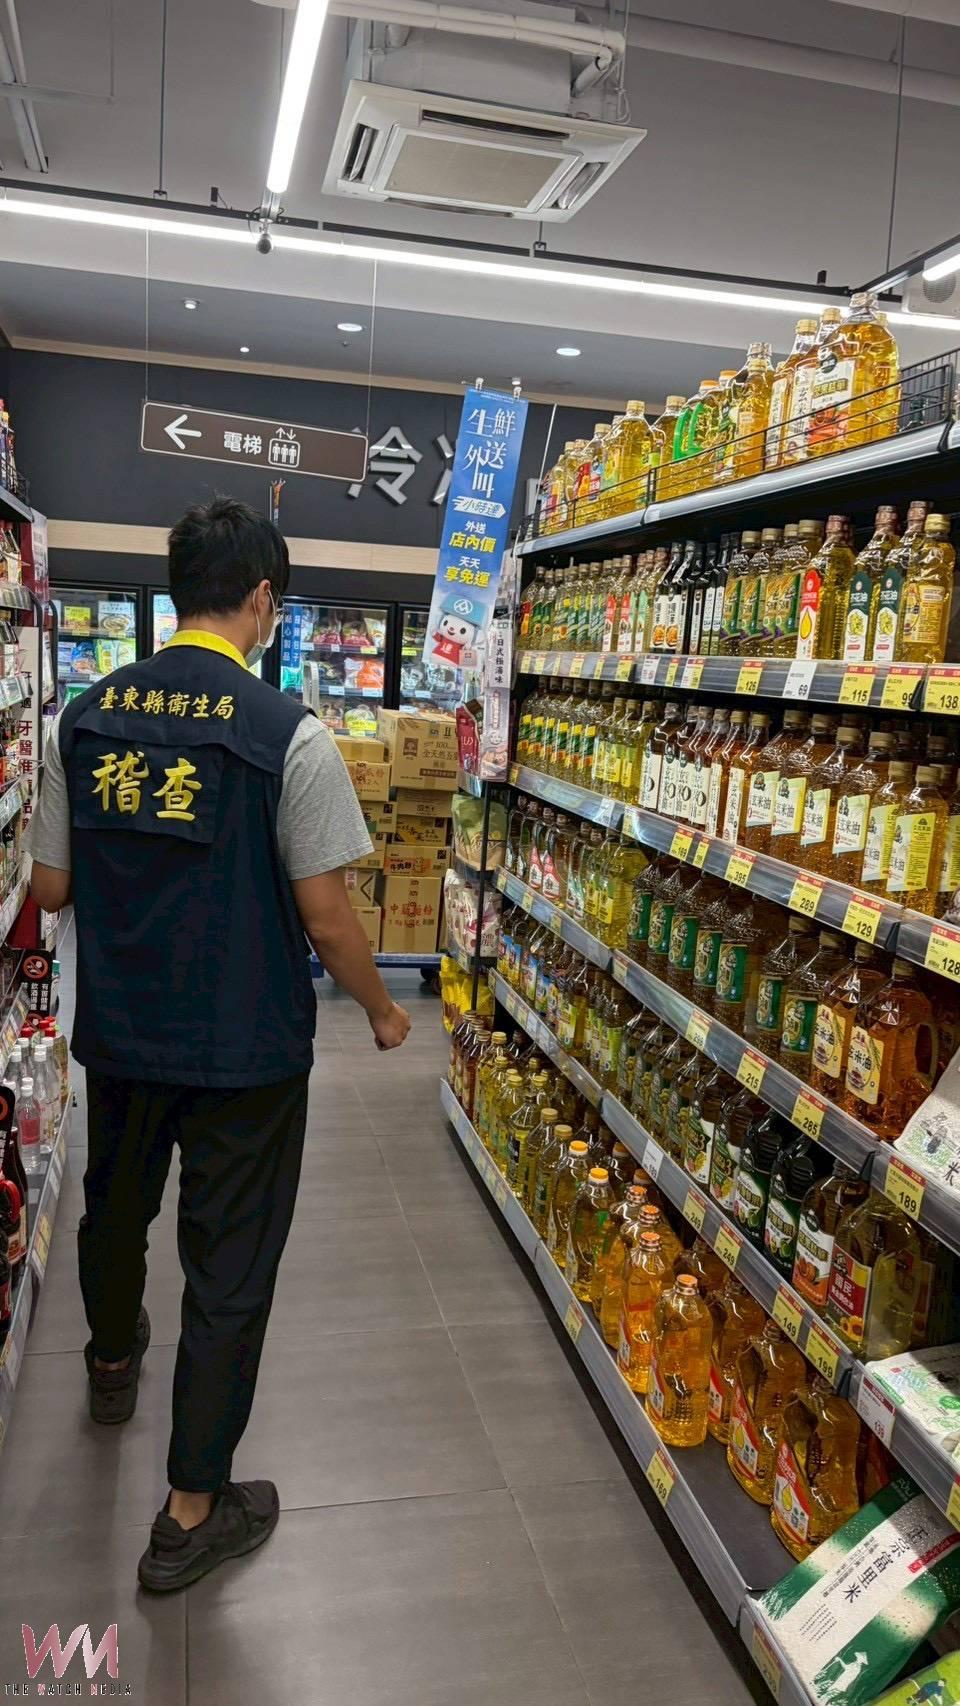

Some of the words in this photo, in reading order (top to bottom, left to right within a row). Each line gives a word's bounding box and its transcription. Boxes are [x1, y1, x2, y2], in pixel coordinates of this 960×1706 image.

[465, 407, 516, 438] 生鮮
[223, 431, 263, 456] 電梯
[465, 520, 486, 535] 外送
[449, 532, 497, 553] 店內價
[459, 556, 480, 569] 天天
[444, 566, 491, 588] 享免運
[99, 685, 235, 720] 臺東縣衛生局
[851, 689, 868, 702] 115
[939, 694, 959, 709] 138
[91, 750, 203, 822] 稽查
[799, 897, 815, 913] 289
[856, 920, 873, 938] 129
[941, 957, 960, 976] 128
[745, 1072, 760, 1090] 215
[802, 1117, 819, 1136] 285
[898, 1191, 917, 1213] 189
[782, 1317, 797, 1337] 149
[818, 1356, 834, 1379] 199
[654, 1479, 667, 1500] 169
